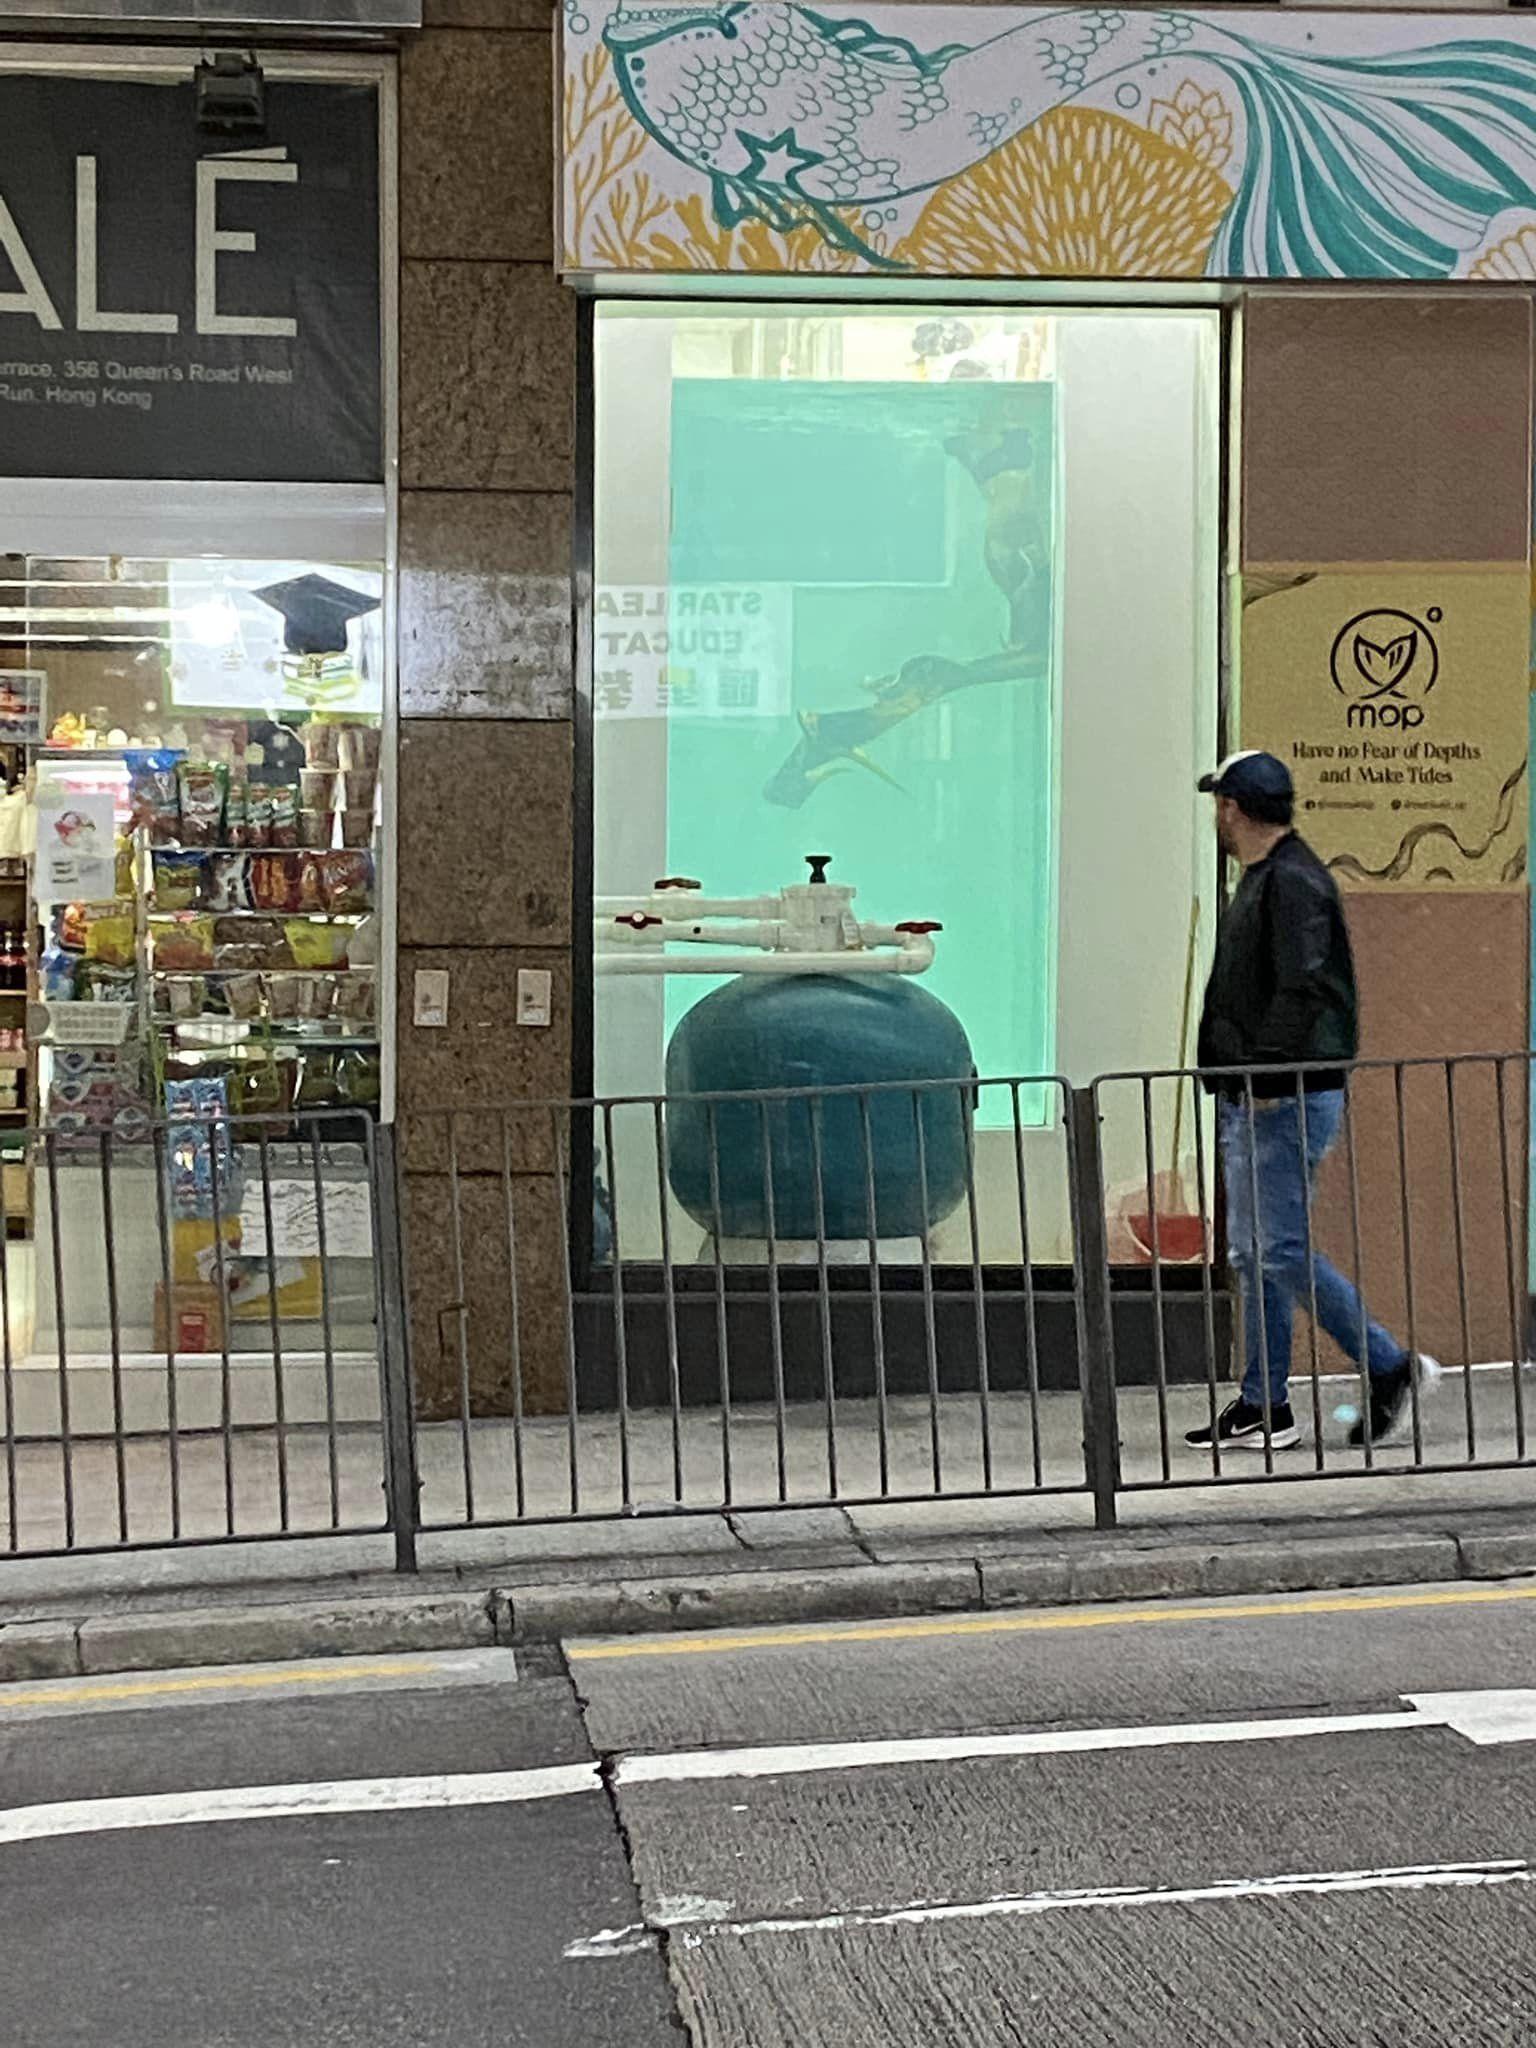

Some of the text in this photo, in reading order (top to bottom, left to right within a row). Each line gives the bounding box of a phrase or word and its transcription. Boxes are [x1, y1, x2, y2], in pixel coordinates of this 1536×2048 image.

[105, 361, 183, 381] Queen's
[189, 363, 240, 382] Road
[45, 386, 96, 407] Hong
[102, 386, 152, 410] Kong
[1348, 704, 1424, 730] mop
[1293, 741, 1481, 764] Have no Fear of Depths
[1319, 766, 1453, 784] and Make Tides
